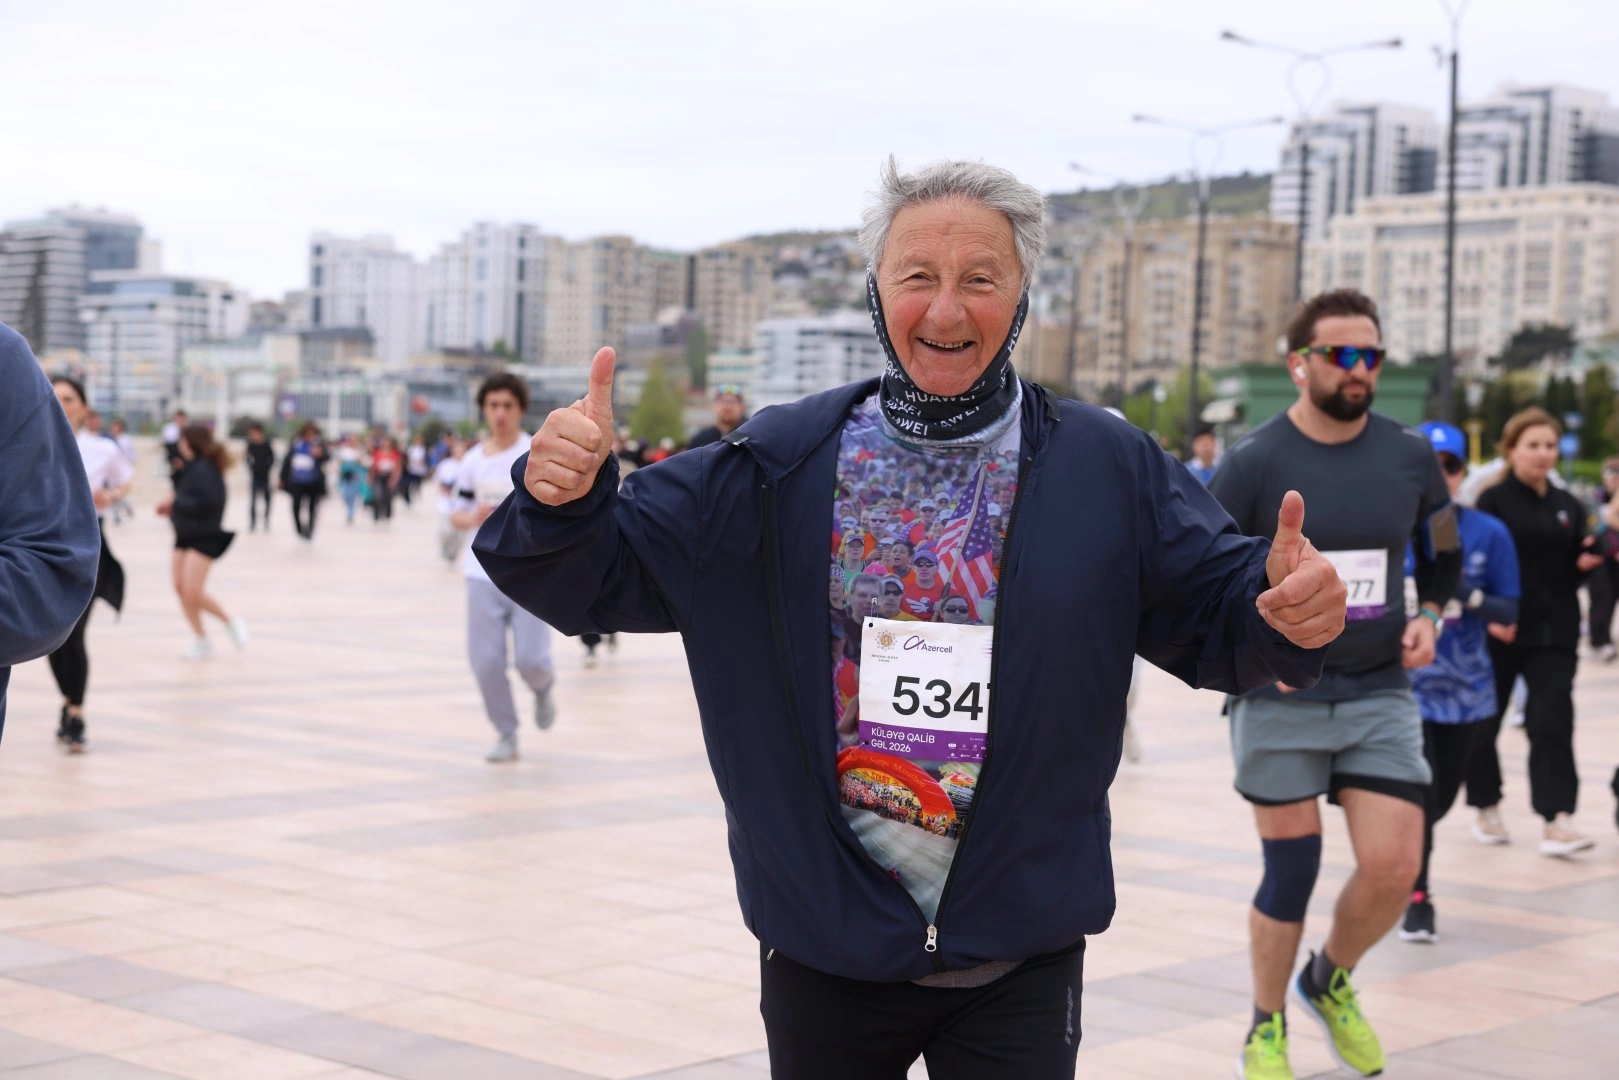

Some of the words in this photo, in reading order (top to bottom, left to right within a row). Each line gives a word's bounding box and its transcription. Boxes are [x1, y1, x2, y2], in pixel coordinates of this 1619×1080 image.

[1343, 579, 1375, 601] 77
[921, 643, 953, 654] Azercell
[892, 675, 991, 721] 534
[906, 732, 936, 744] QALİB
[870, 739, 888, 750] GƏL
[888, 741, 912, 753] 2026
[871, 771, 891, 786] START
